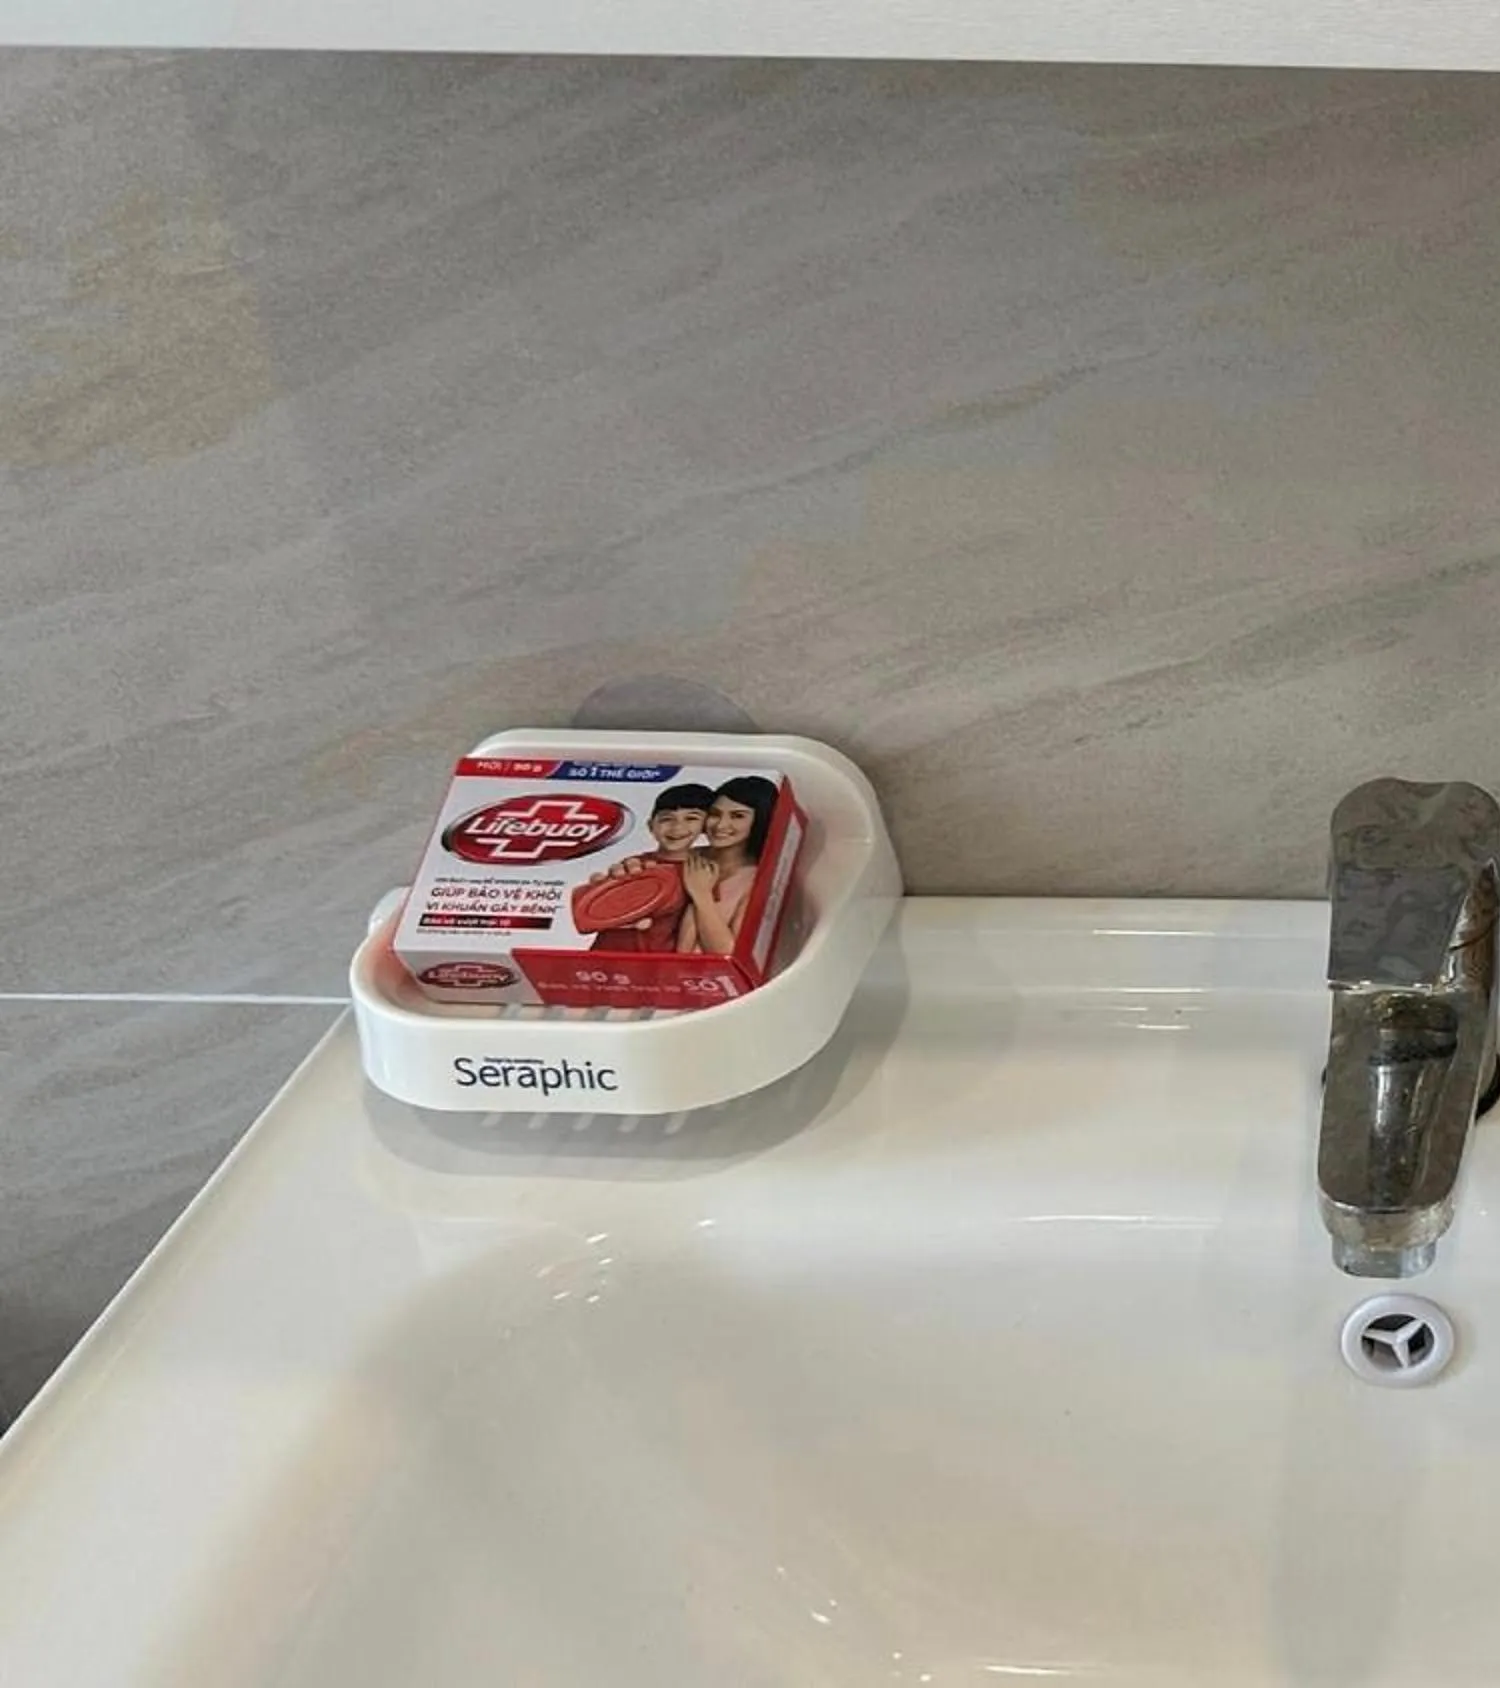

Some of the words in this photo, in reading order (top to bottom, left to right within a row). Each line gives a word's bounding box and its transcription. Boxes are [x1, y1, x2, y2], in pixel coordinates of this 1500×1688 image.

[465, 816, 611, 843] Lifebuoy
[426, 901, 440, 912] VI
[453, 1057, 618, 1097] Seraphic
